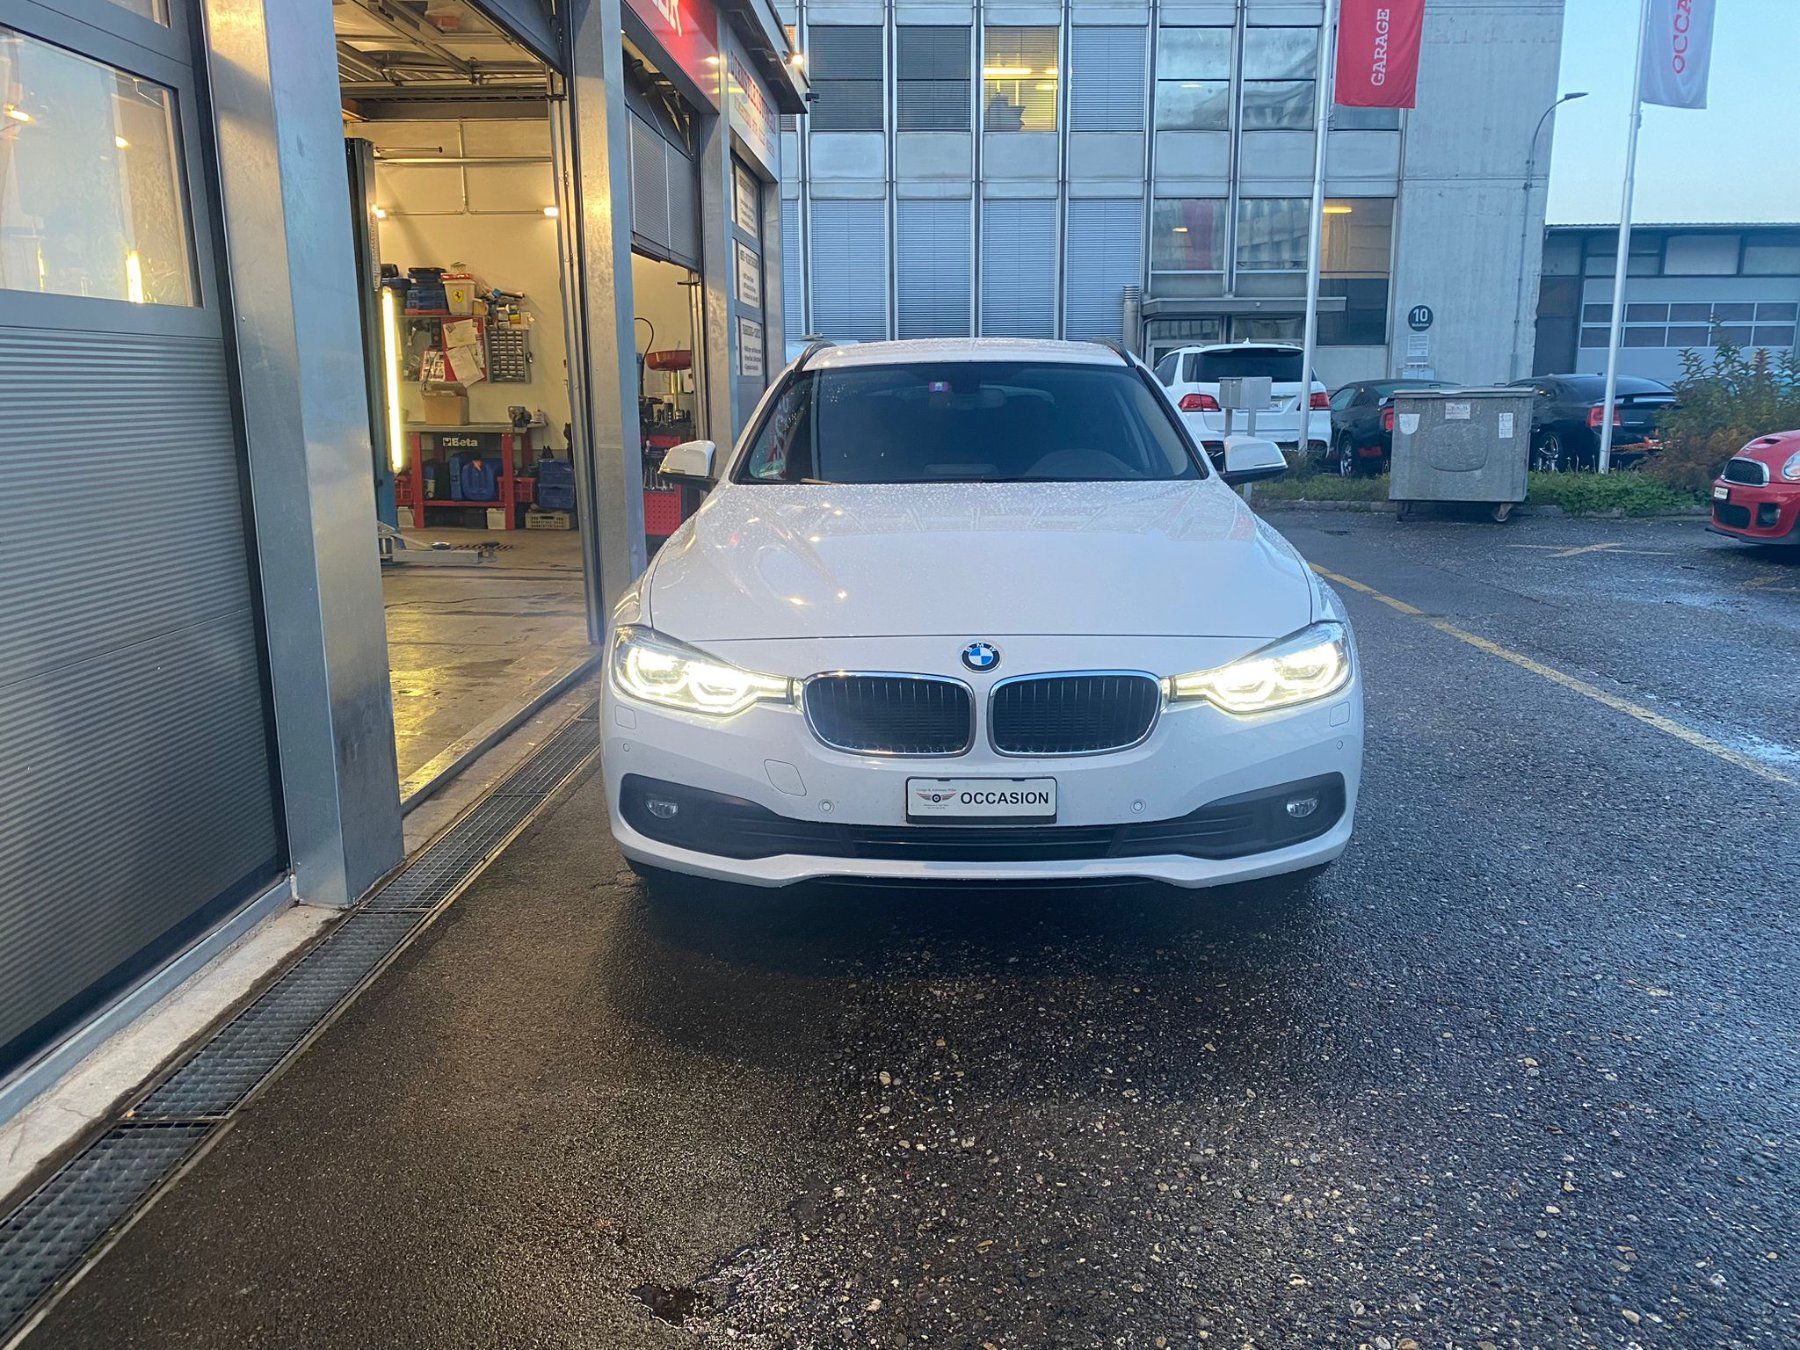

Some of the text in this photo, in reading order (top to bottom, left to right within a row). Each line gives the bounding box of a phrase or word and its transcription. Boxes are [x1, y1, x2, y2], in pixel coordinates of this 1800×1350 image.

[1370, 8, 1390, 86] GARAGE
[1413, 308, 1428, 322] 10
[451, 437, 479, 447] Beta
[960, 791, 1049, 805] OCCASION
